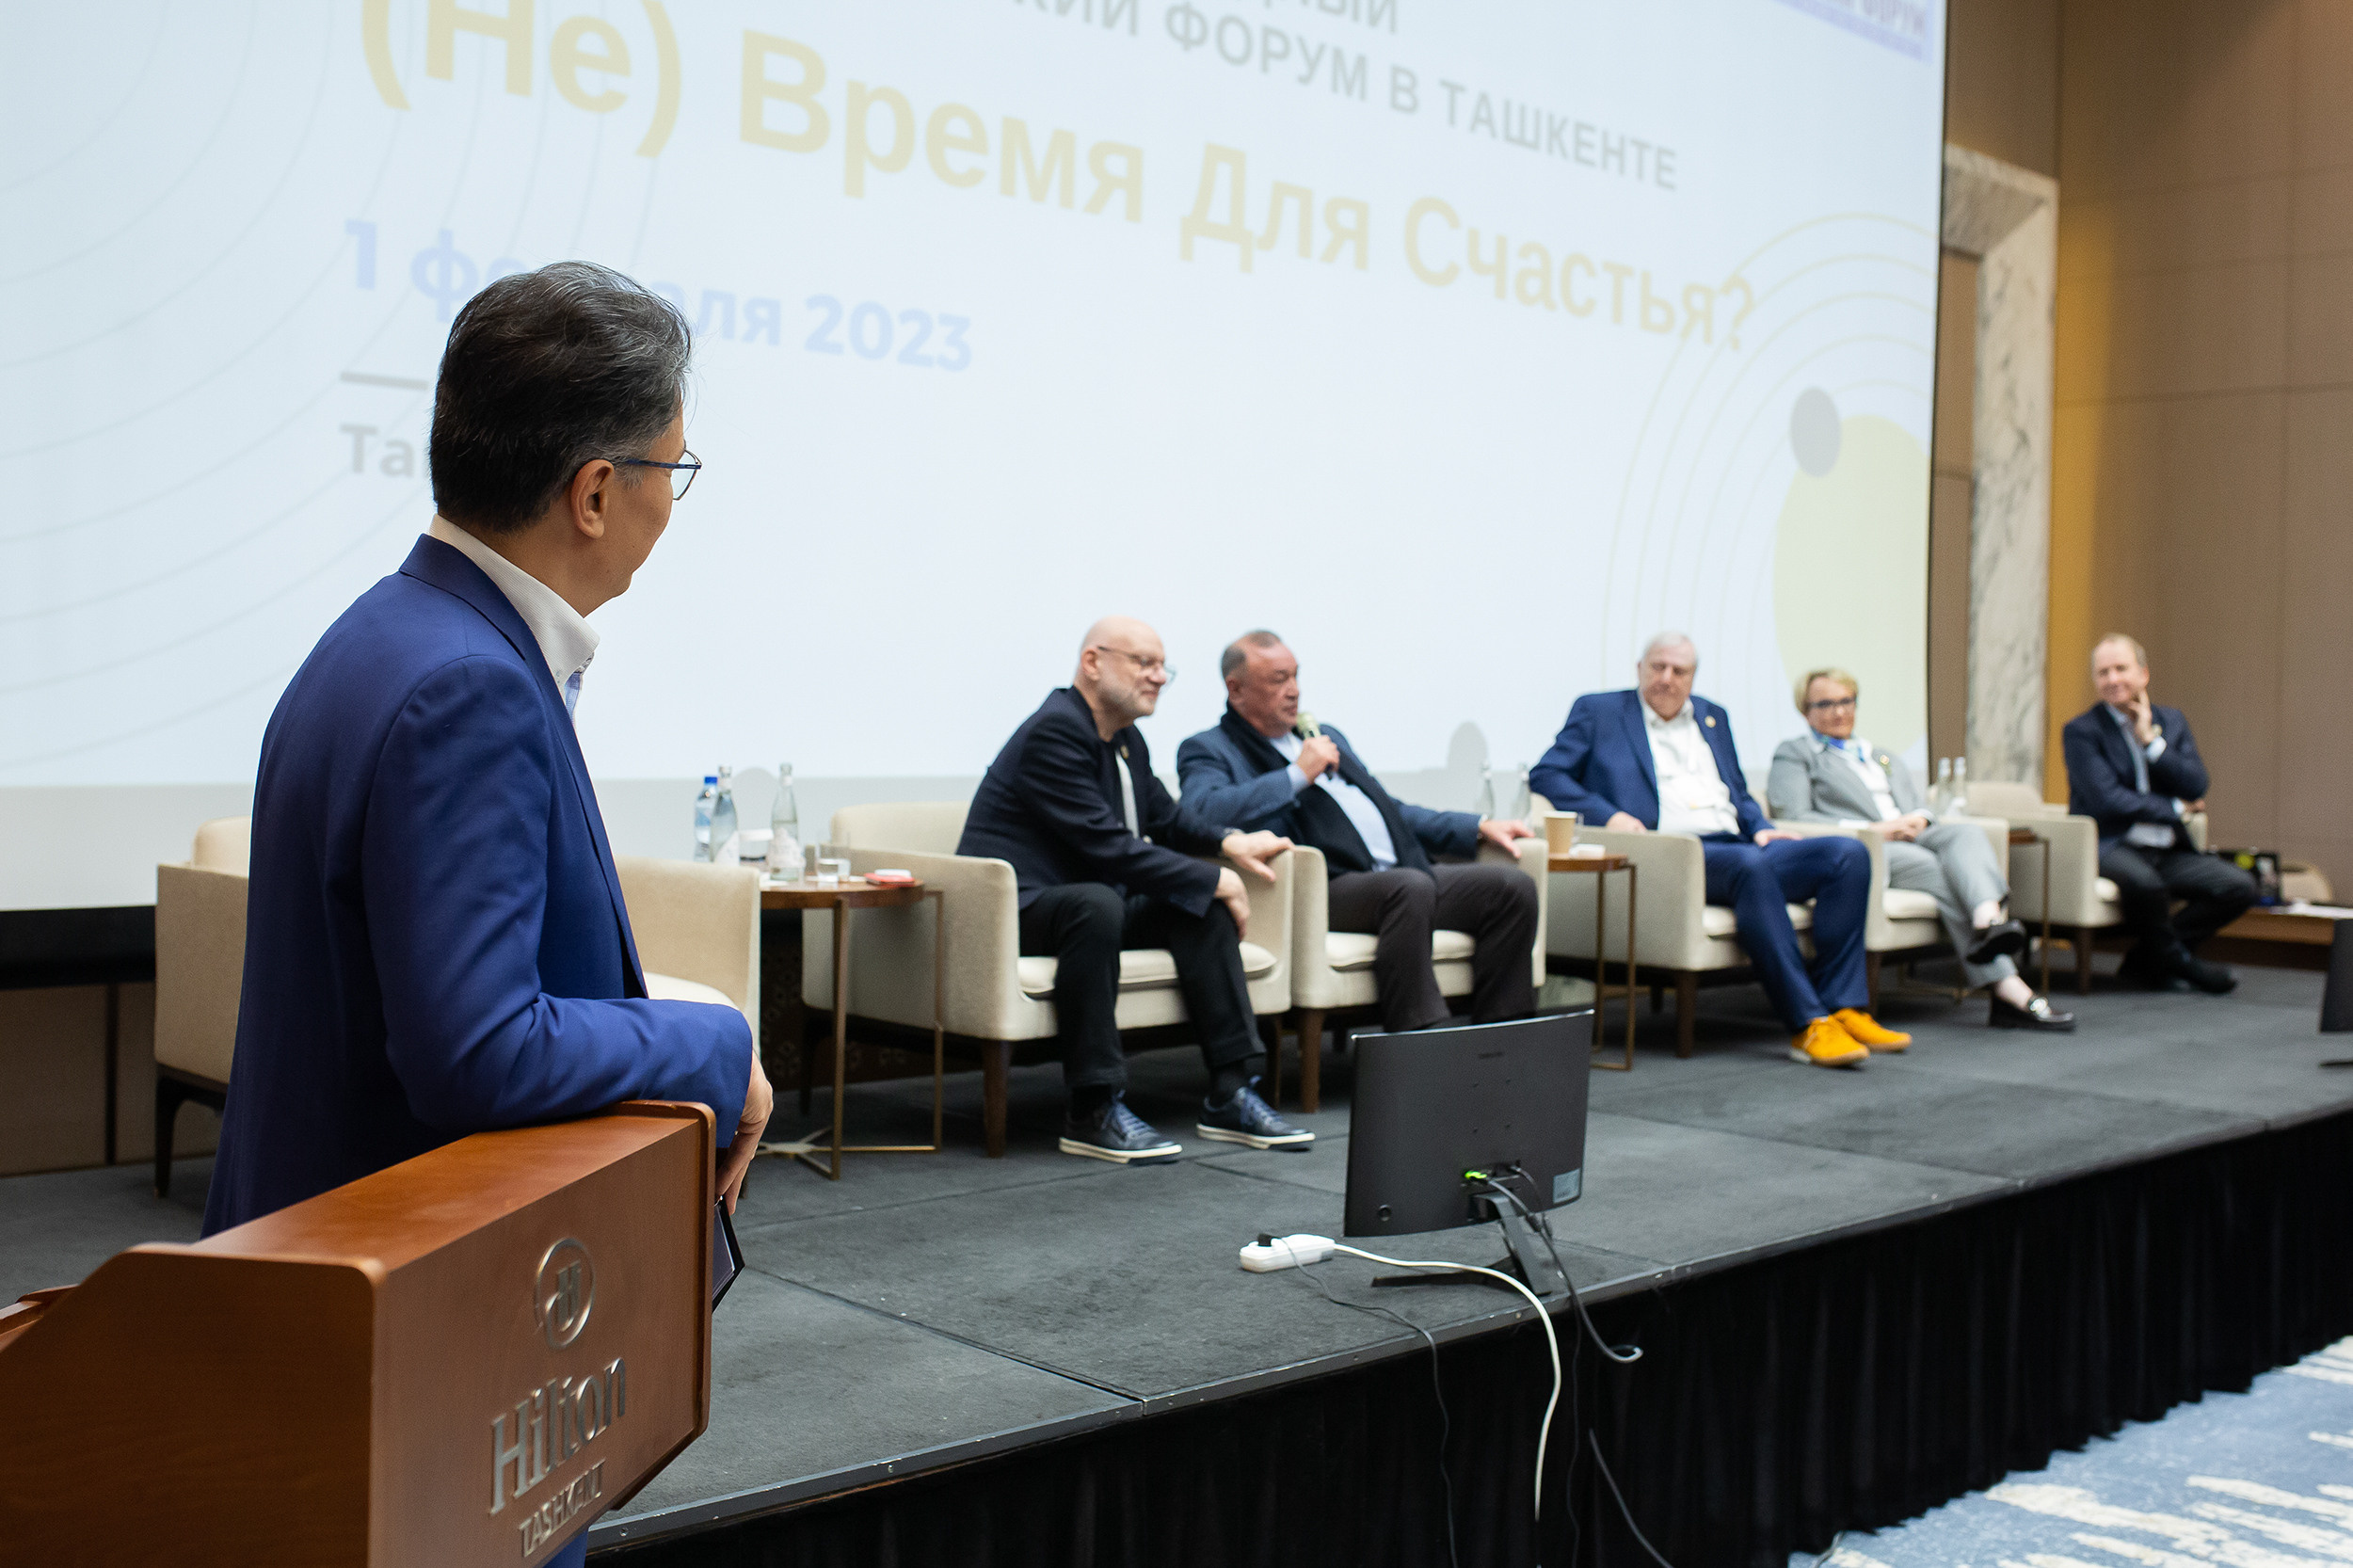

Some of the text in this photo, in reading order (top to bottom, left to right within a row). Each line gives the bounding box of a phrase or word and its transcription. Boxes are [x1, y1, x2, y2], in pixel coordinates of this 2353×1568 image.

[1163, 0, 1369, 102] ФОРУМ
[1389, 63, 1420, 115] В
[1438, 78, 1678, 192] ТАШКЕНТЕ
[360, 0, 1755, 353] (Не) Время Для Счастья?
[344, 218, 377, 291] 1
[804, 294, 972, 373] 2023
[489, 1356, 626, 1516] Hilton
[519, 1458, 606, 1558] TASHKENT
